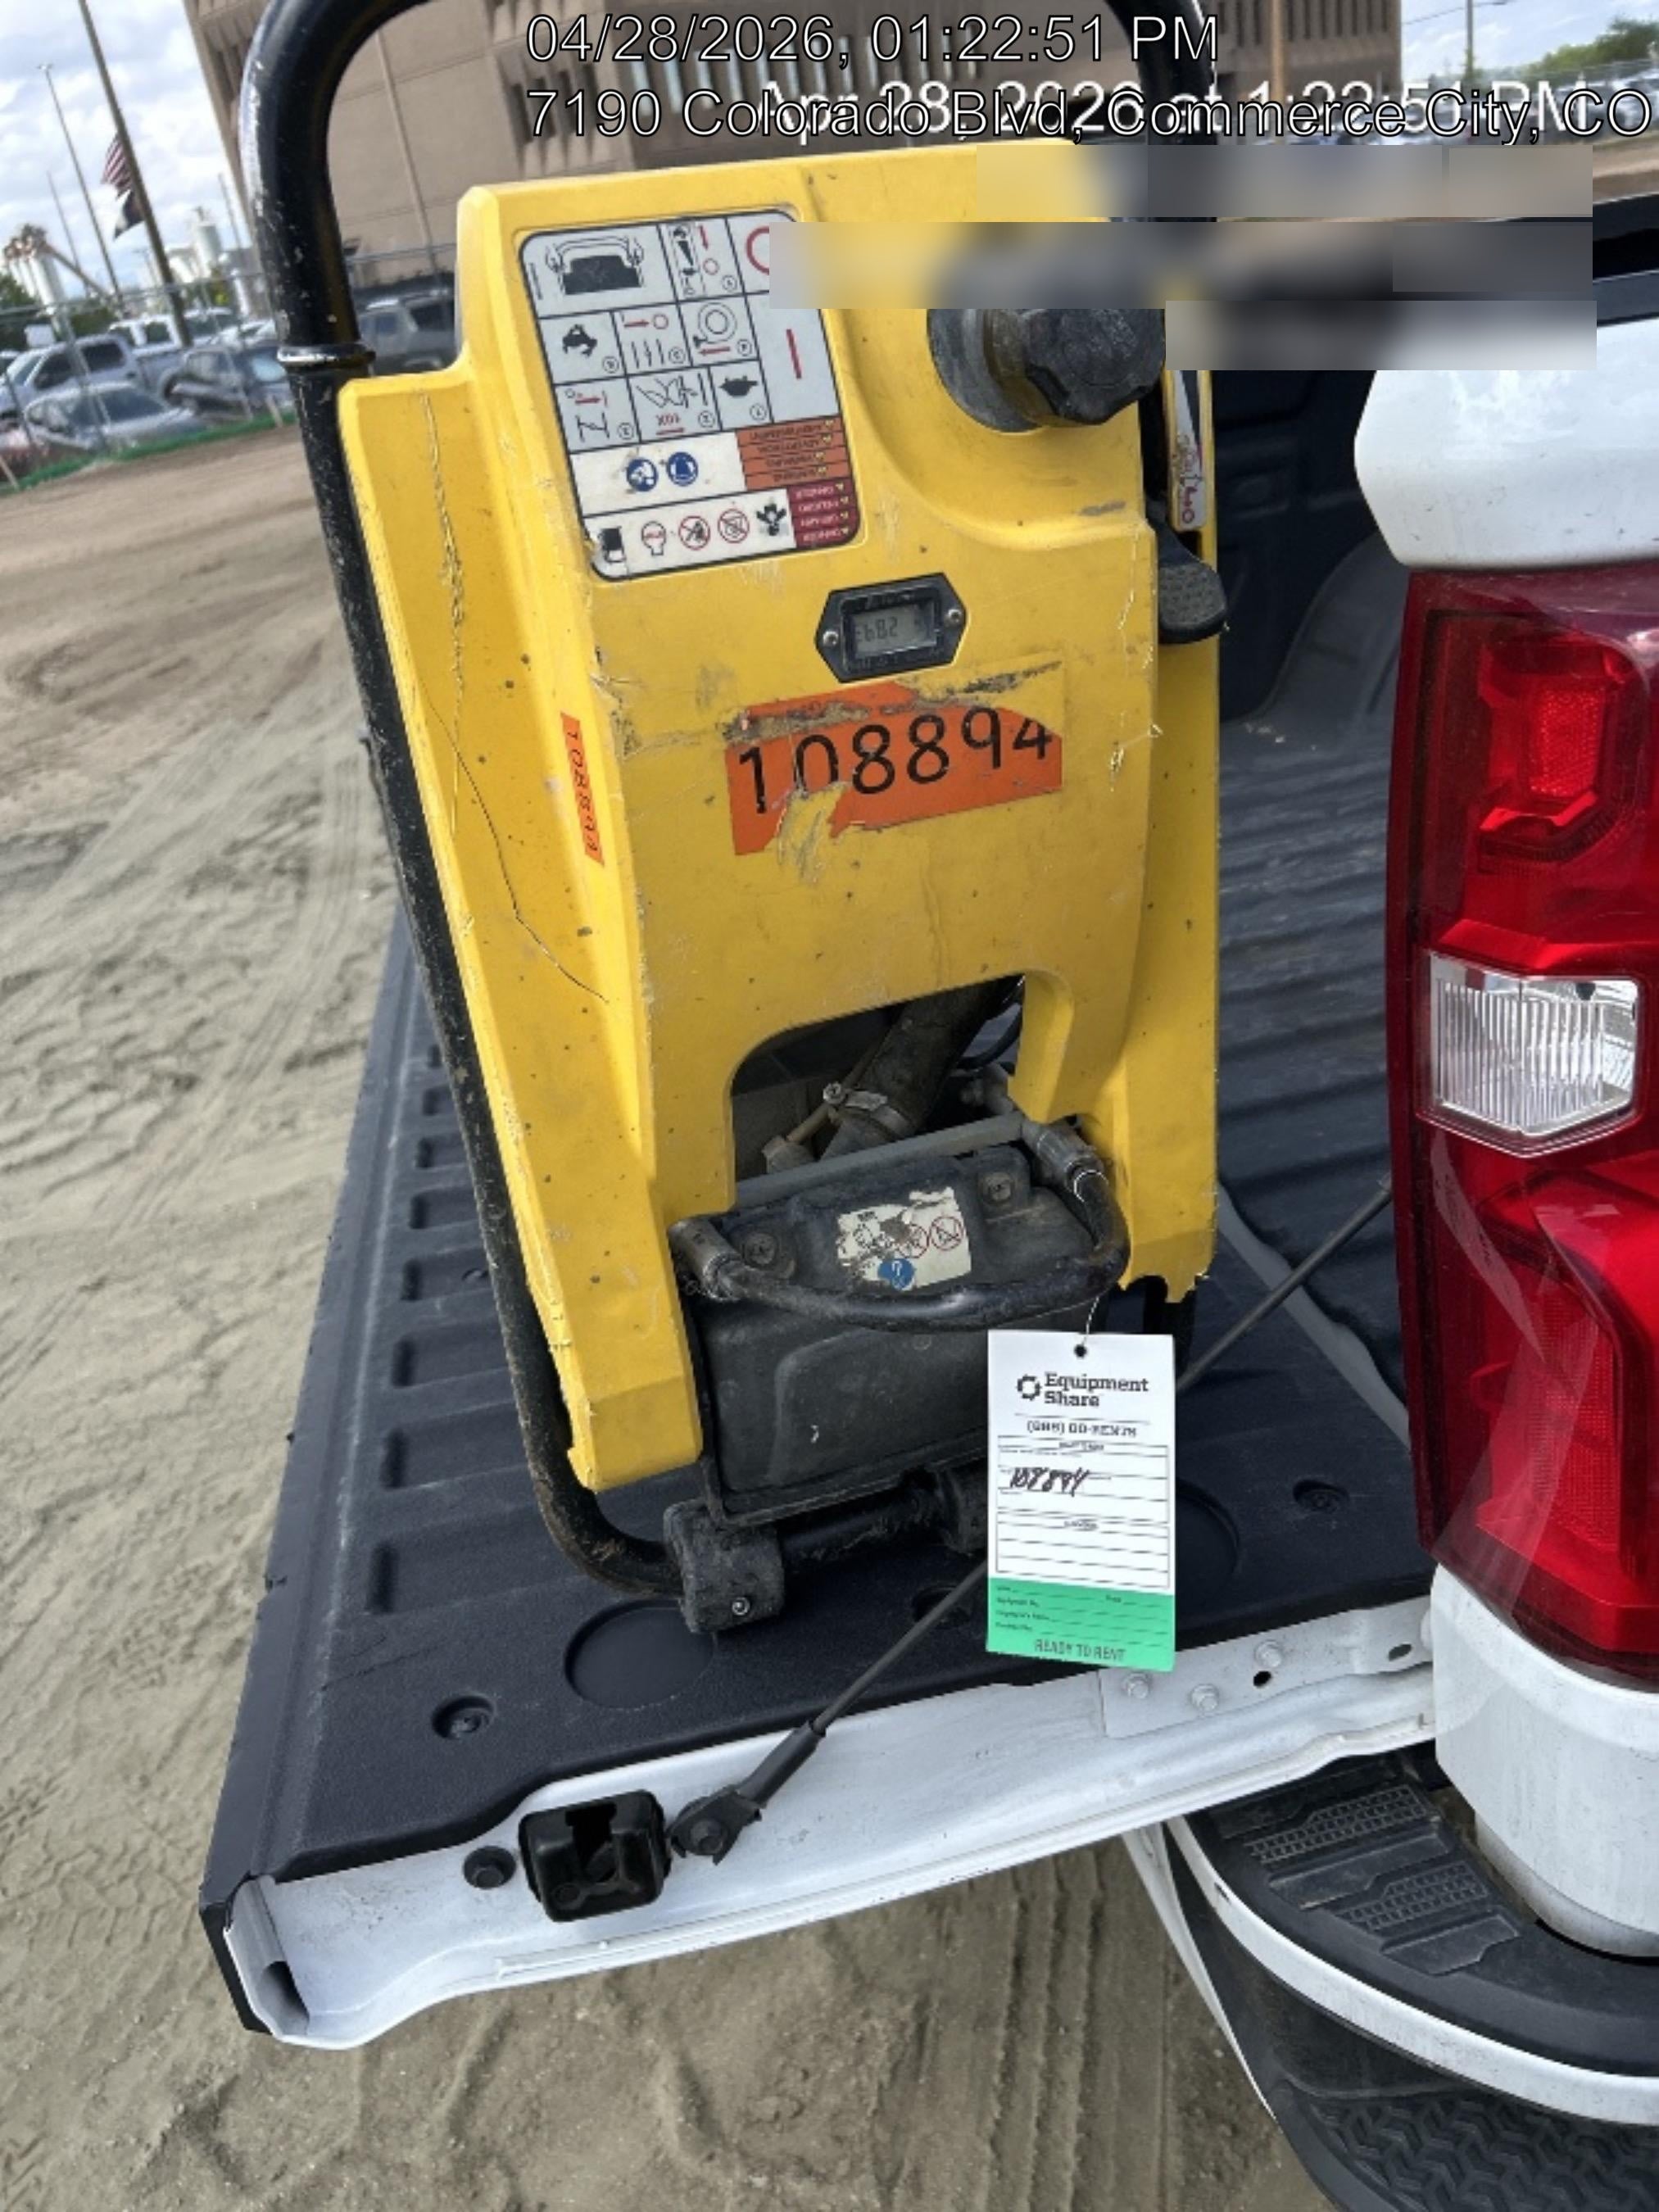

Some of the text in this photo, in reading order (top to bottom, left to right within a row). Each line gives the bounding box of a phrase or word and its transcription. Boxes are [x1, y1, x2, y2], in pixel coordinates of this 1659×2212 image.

[739, 705, 1054, 814] 108894
[1044, 1373, 1149, 1392] Equipment
[1044, 1390, 1099, 1407] Share
[1035, 1638, 1127, 1661] READY TO RENT
